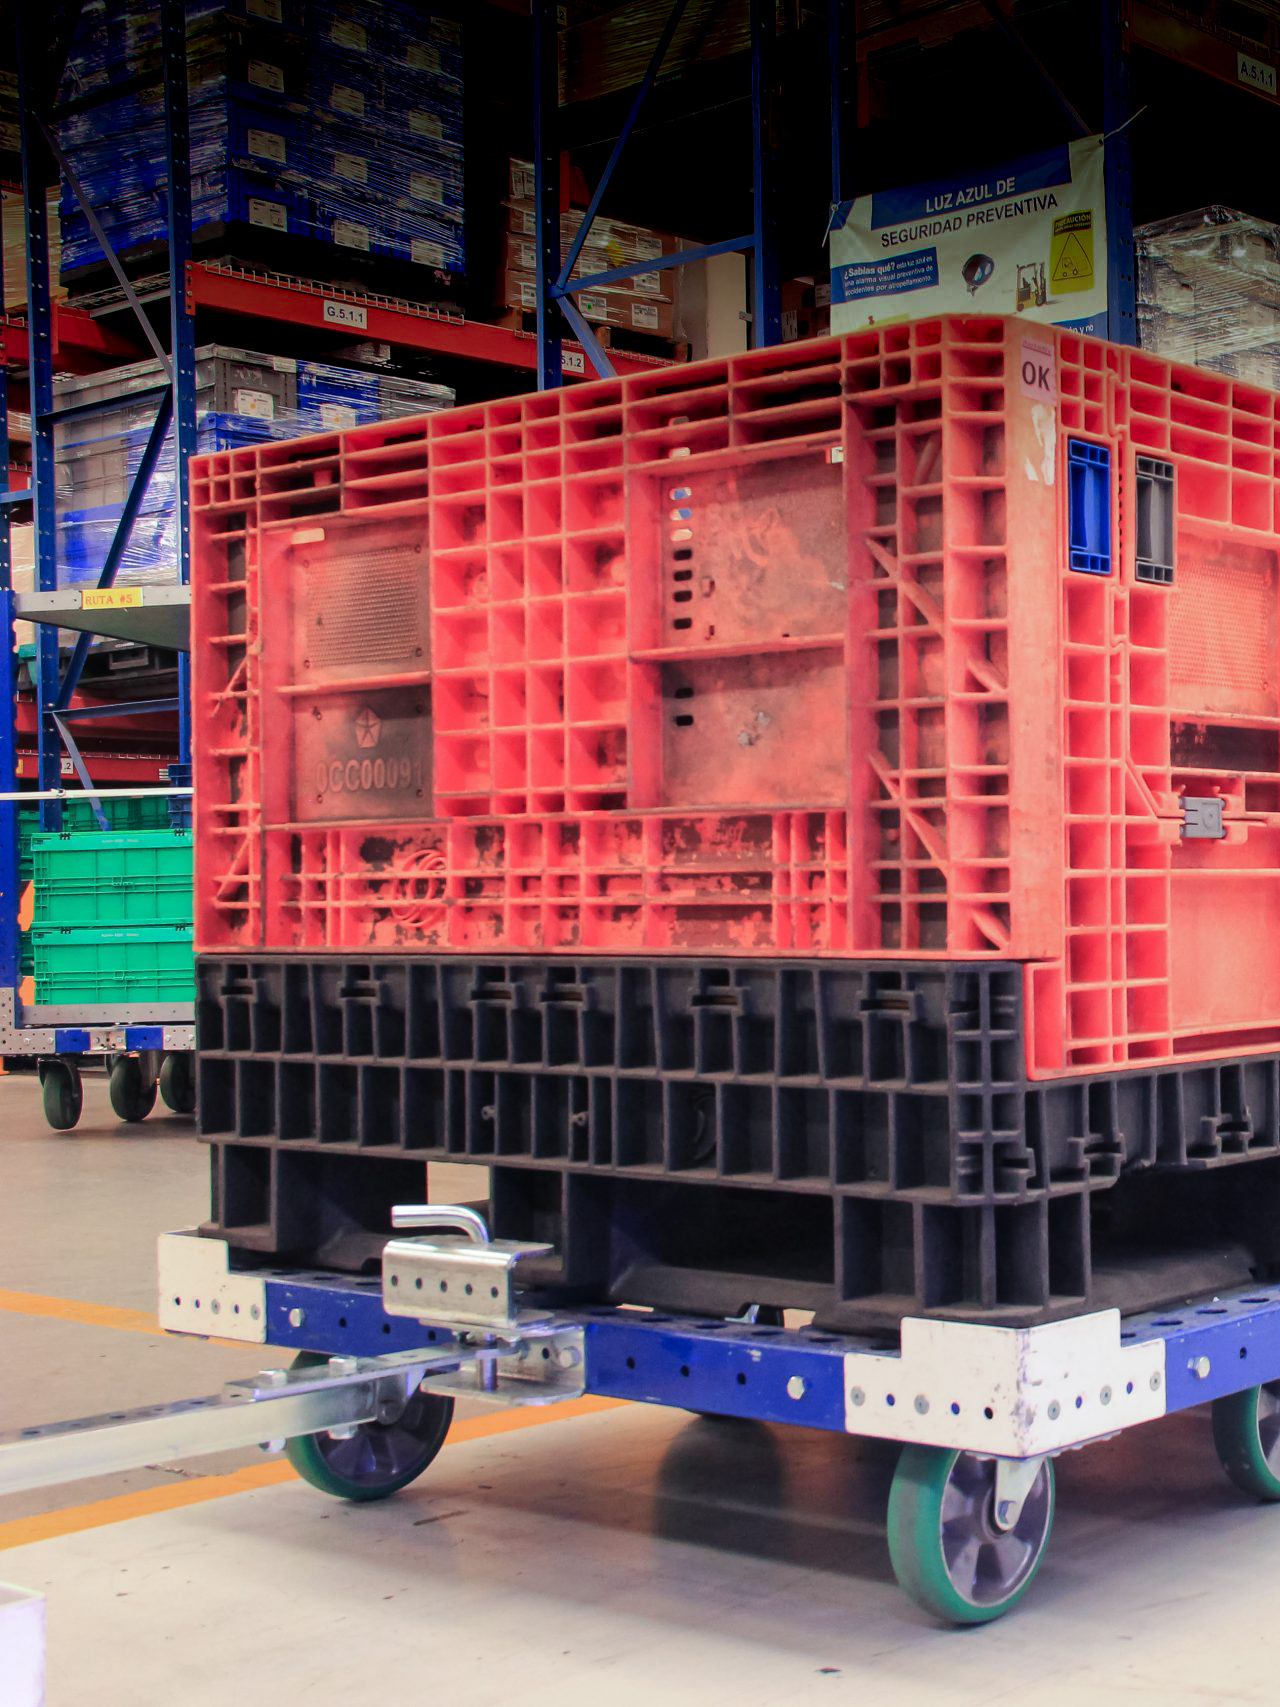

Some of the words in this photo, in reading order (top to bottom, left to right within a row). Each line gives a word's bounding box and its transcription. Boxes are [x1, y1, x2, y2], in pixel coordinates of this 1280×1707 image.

[1241, 61, 1273, 87] A.5.1.1
[926, 193, 953, 213] LUZ
[955, 183, 993, 206] AZUL
[996, 176, 1016, 195] DE
[881, 217, 962, 248] SEGURIDAD
[966, 193, 1058, 228] PREVENTIVA
[855, 277, 877, 285] alarma
[878, 273, 896, 282] visual
[896, 267, 925, 280] preventiva
[876, 285, 888, 293] por
[327, 306, 363, 323] G.5.1.1
[1085, 324, 1094, 332] no
[1022, 361, 1050, 391] OK
[85, 595, 114, 605] RUTA
[119, 594, 133, 604] #5
